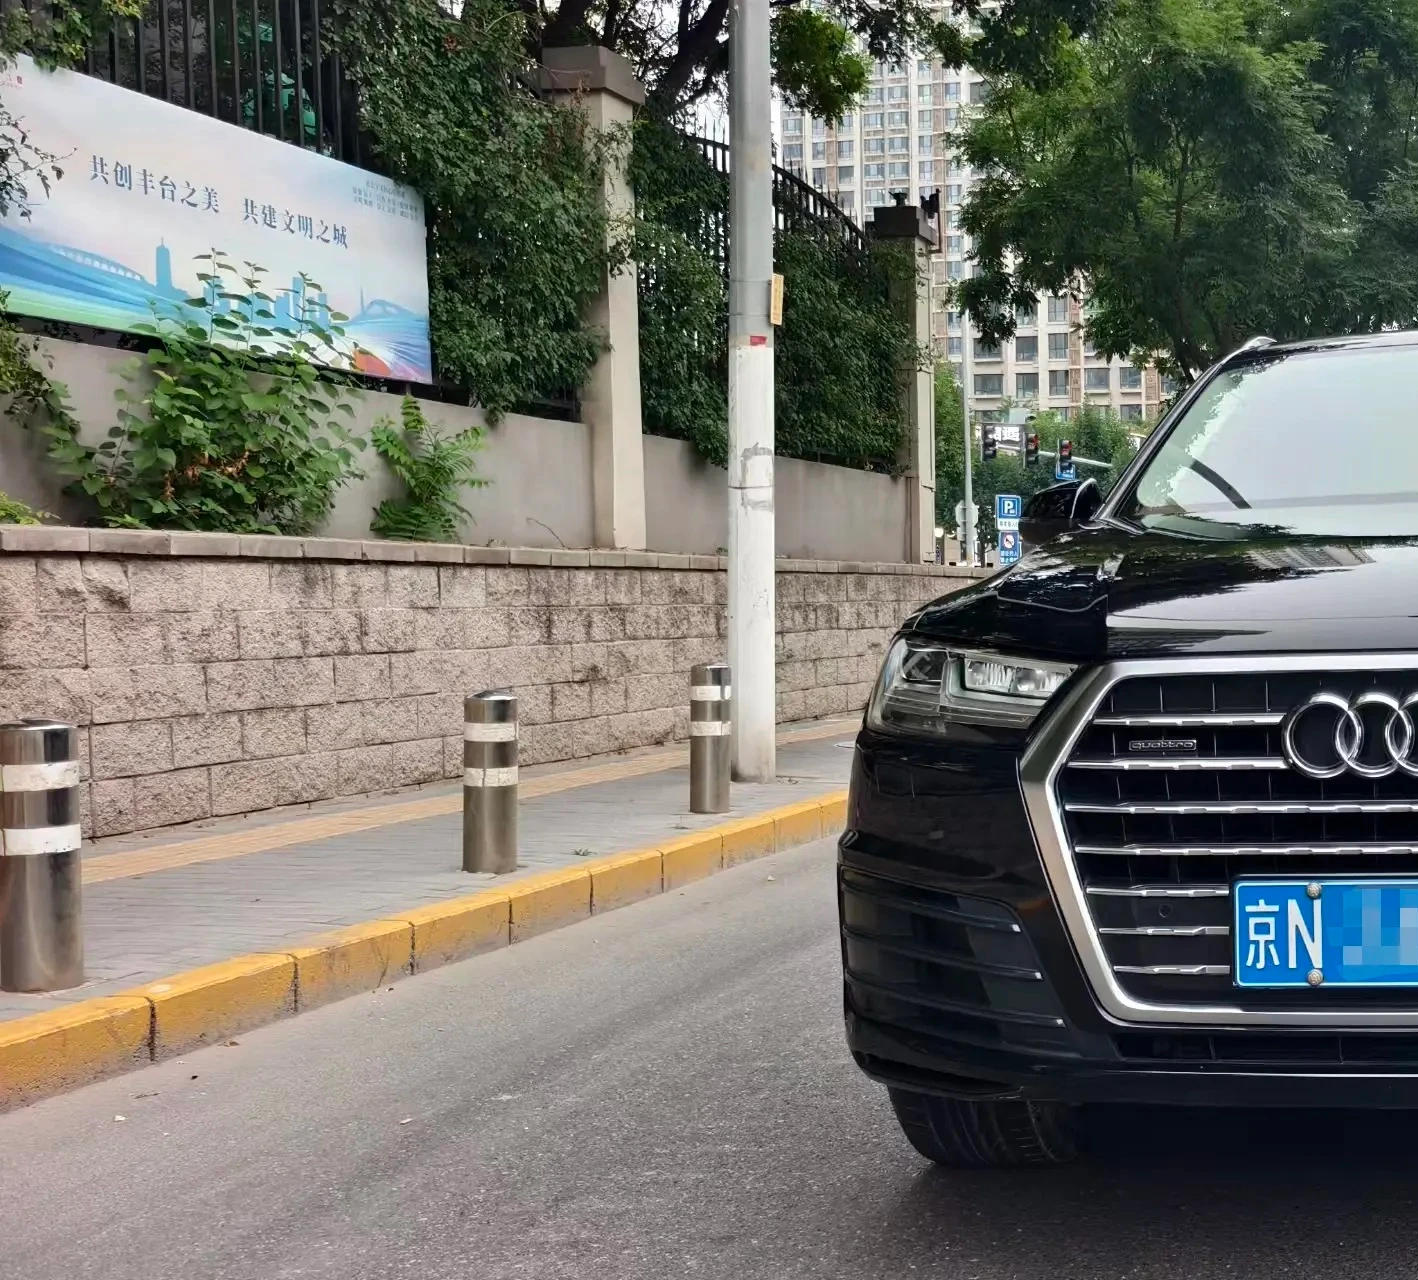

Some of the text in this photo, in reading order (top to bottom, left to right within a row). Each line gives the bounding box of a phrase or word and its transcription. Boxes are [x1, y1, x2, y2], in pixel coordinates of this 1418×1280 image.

[90, 155, 219, 213] 共创丰台之美
[243, 197, 348, 249] 共建文明之城
[1132, 741, 1194, 750] quattro
